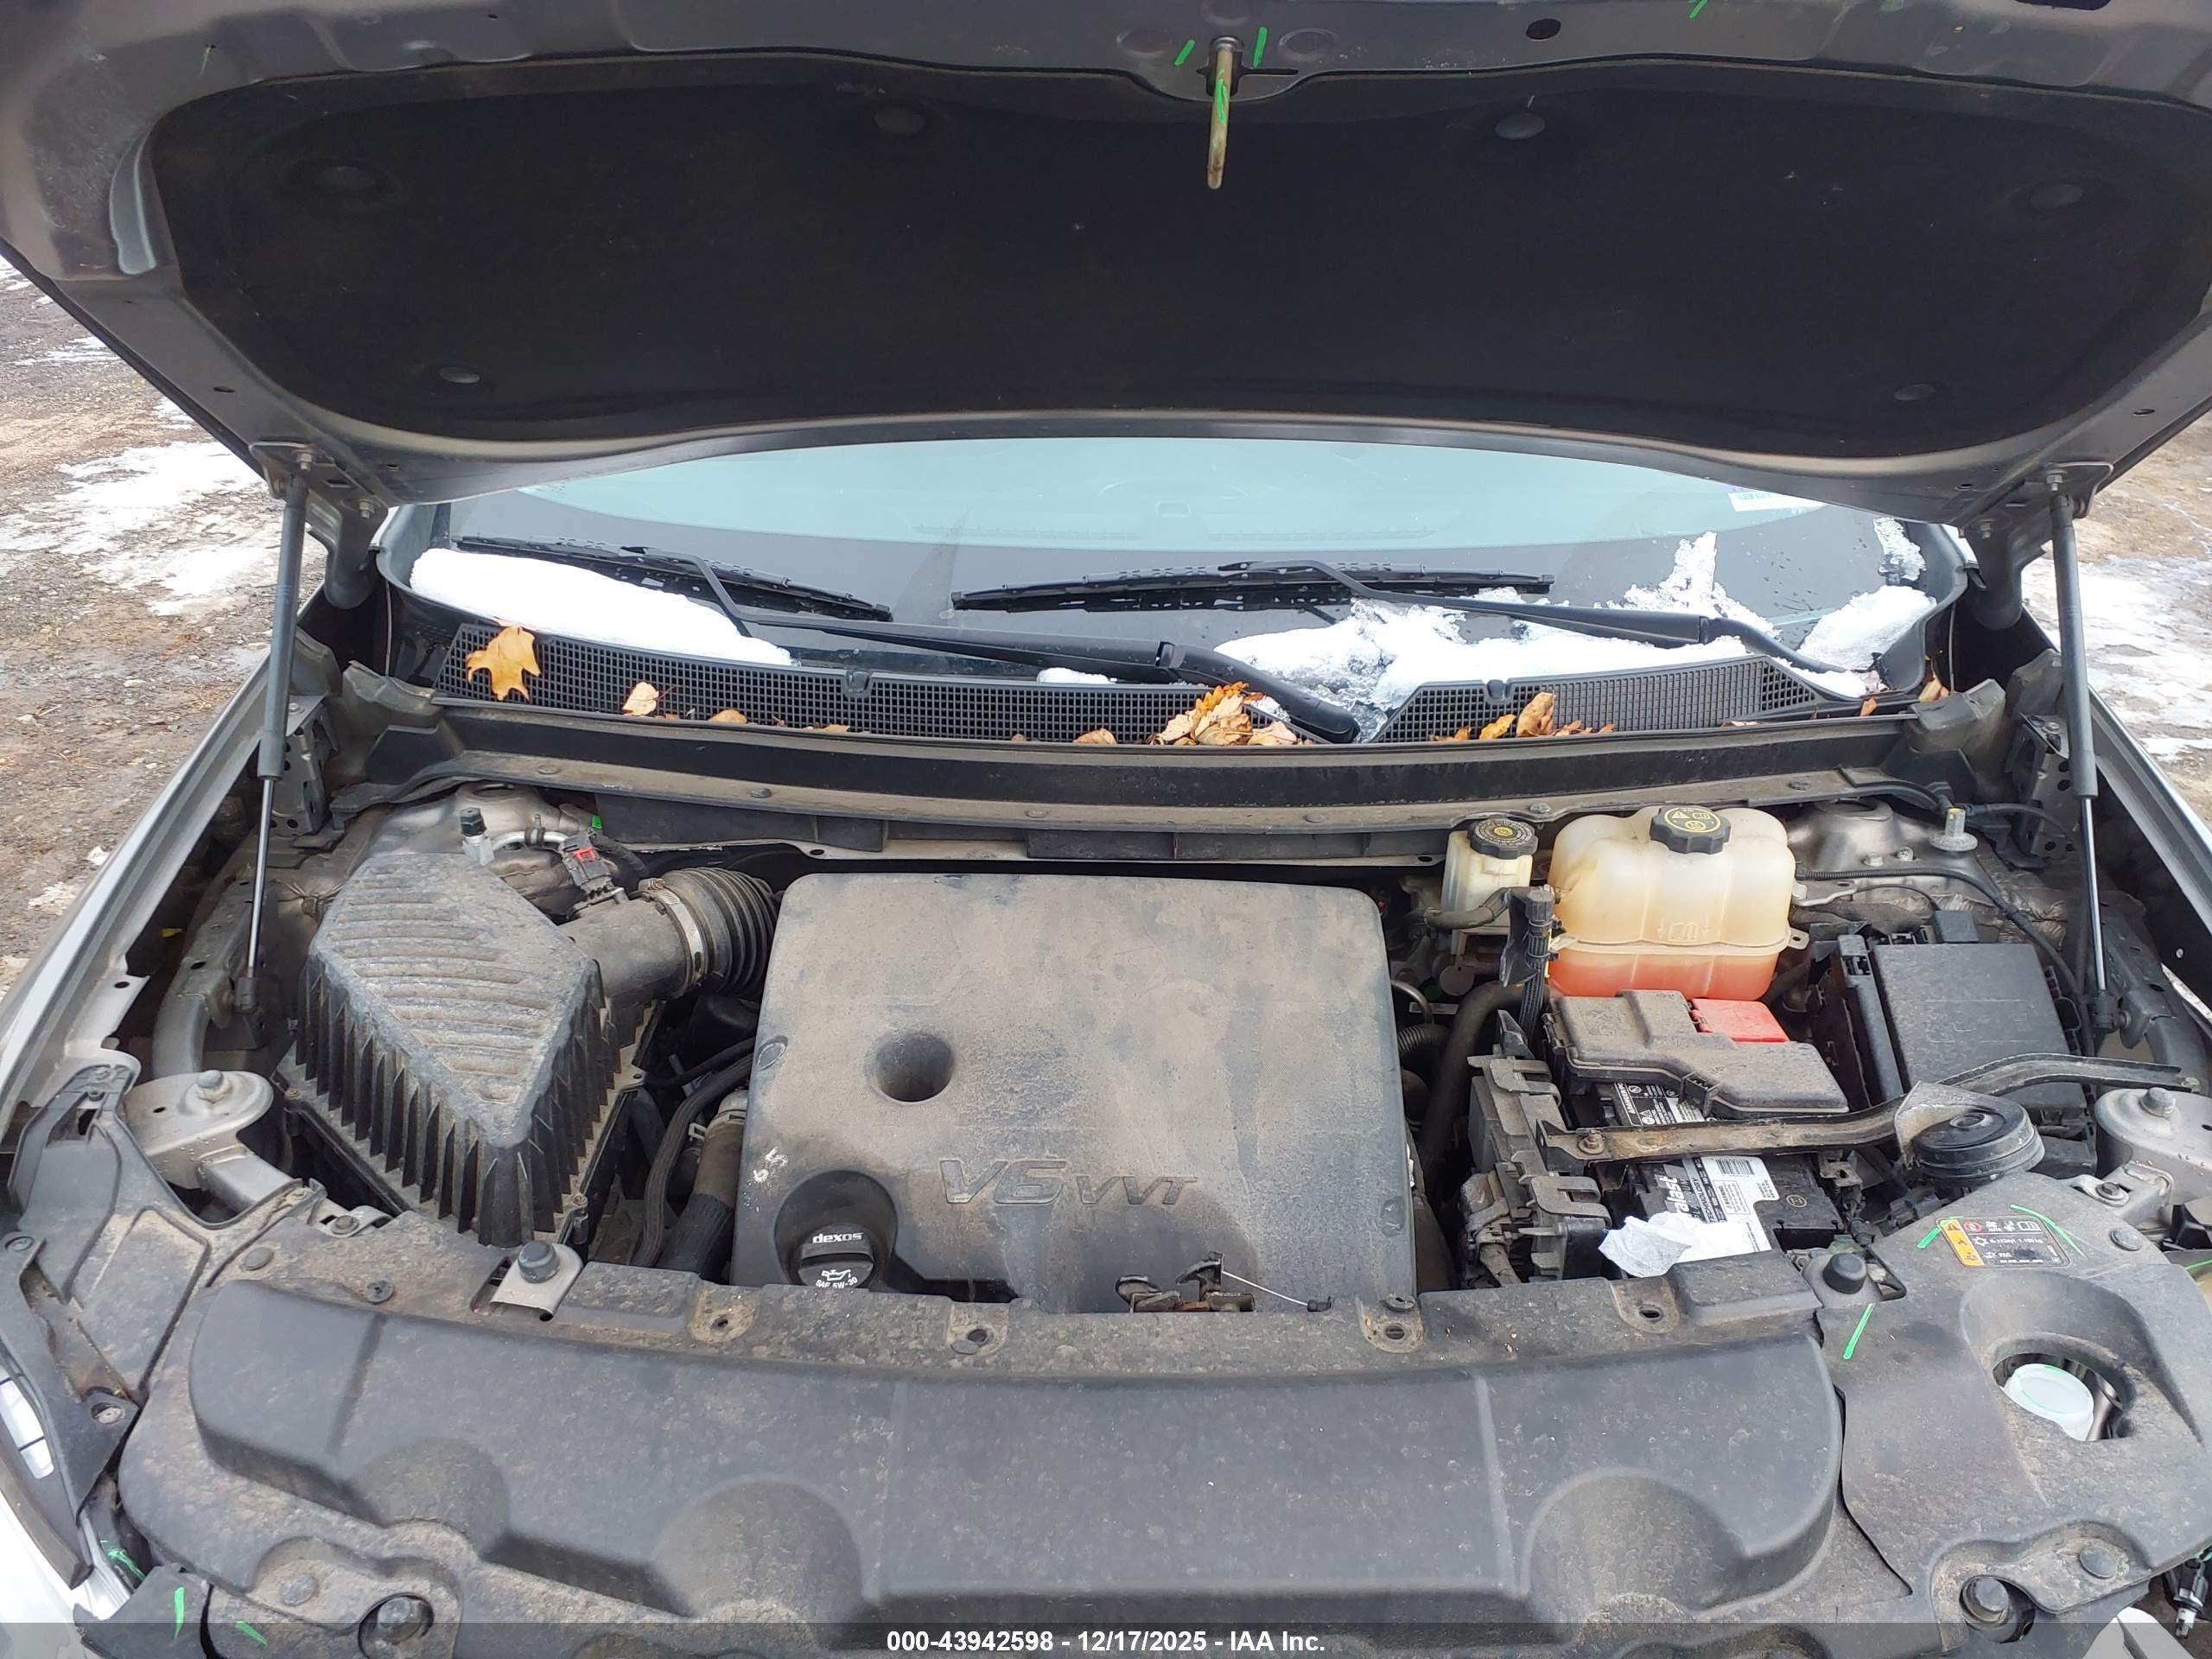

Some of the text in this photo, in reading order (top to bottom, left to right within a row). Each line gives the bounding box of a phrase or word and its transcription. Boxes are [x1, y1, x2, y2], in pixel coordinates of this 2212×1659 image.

[938, 1157, 1199, 1205] V6 VVT
[1659, 1175, 1690, 1214] ralast
[1691, 1177, 1715, 1223] TECHNOLOGY
[812, 1232, 864, 1244] dexos
